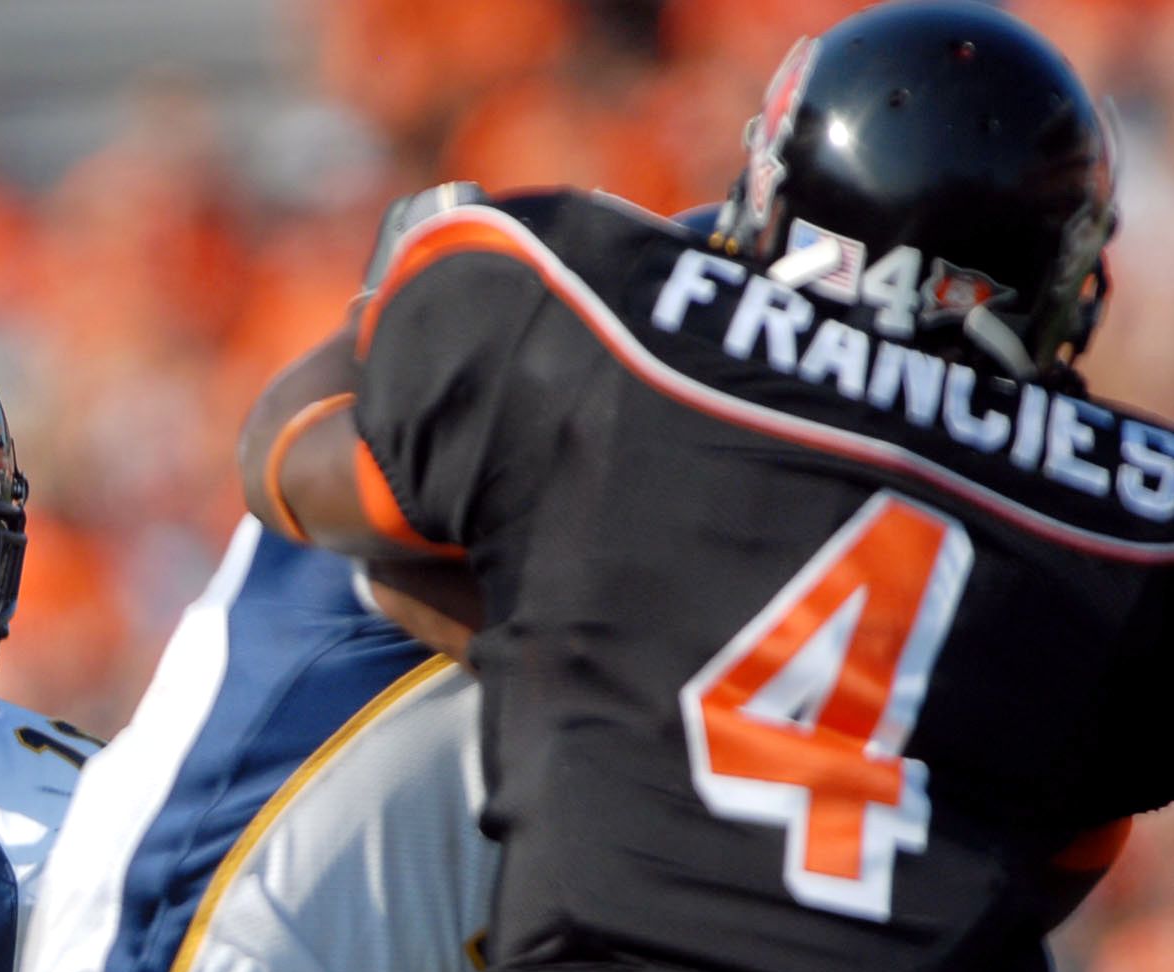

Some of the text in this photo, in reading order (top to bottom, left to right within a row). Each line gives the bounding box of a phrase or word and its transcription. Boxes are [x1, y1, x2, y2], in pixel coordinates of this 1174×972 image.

[652, 248, 1174, 522] FRANCIES
[862, 245, 923, 339] 4
[679, 488, 975, 924] 4
